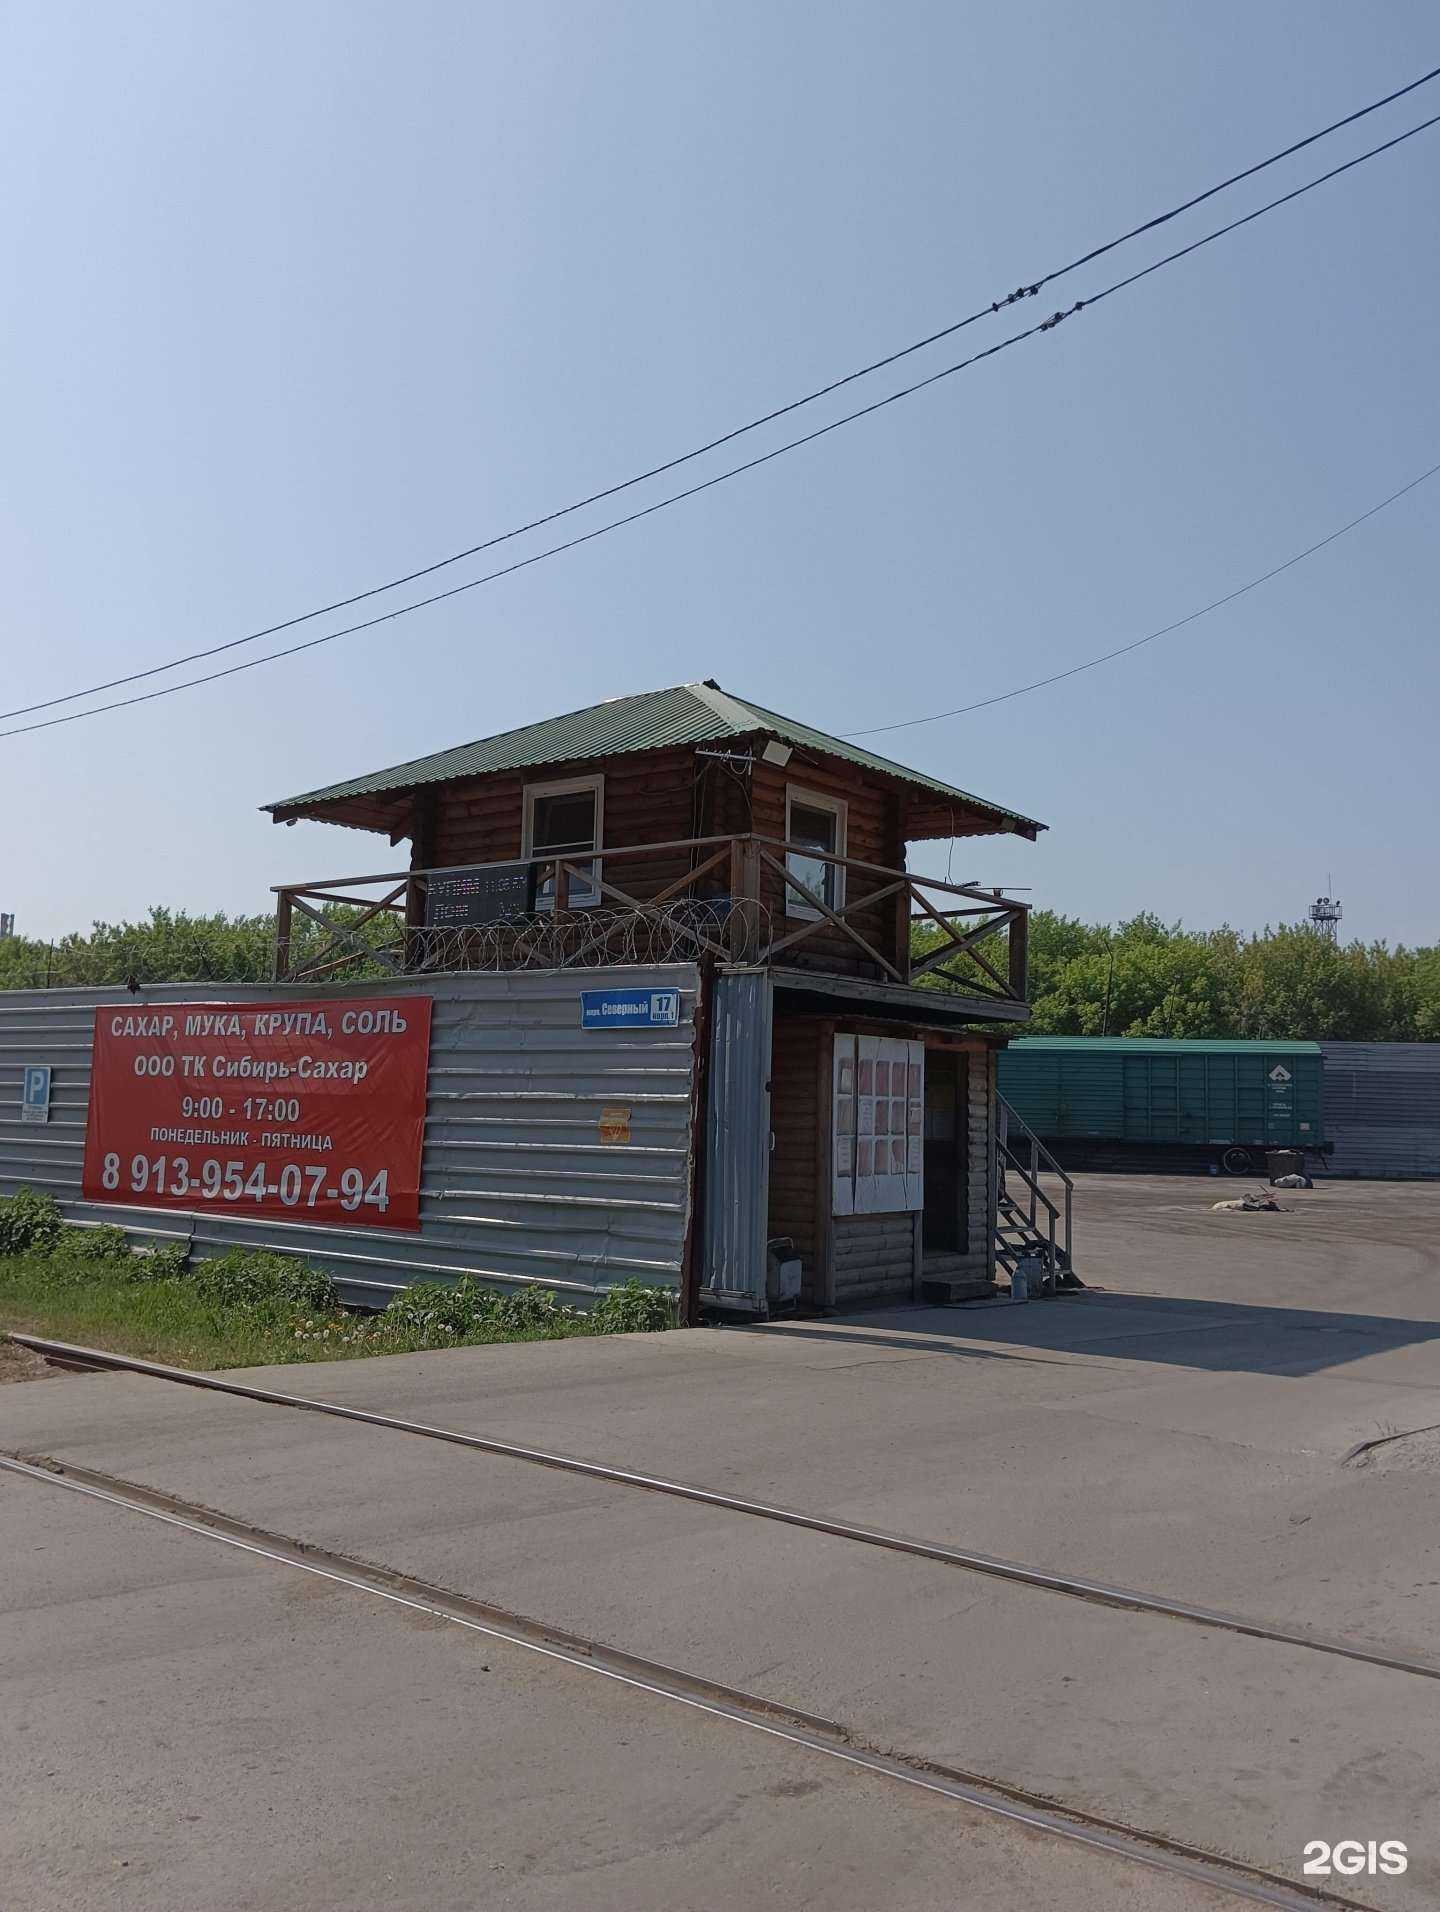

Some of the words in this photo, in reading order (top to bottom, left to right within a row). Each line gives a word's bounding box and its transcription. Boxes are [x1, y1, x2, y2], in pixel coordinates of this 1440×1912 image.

[602, 1001, 649, 1016] Северный
[656, 996, 671, 1011] 17
[111, 1016, 178, 1041] САХАР,
[185, 1015, 247, 1041] МУКА,
[254, 1012, 334, 1039] КРУПА,
[342, 1010, 407, 1035] СОЛЬ
[134, 1055, 175, 1077] ООО
[182, 1055, 206, 1078] ТК
[212, 1055, 368, 1084] Сибирь-Сахар
[181, 1096, 223, 1119] 9:00
[245, 1098, 300, 1121] 17:00
[150, 1128, 249, 1147] ПОНЕДЕЛЬНИК
[261, 1132, 333, 1152] ПЯТНИЦА
[102, 1153, 120, 1190] 8
[130, 1154, 390, 1213] 913-954-07-94
